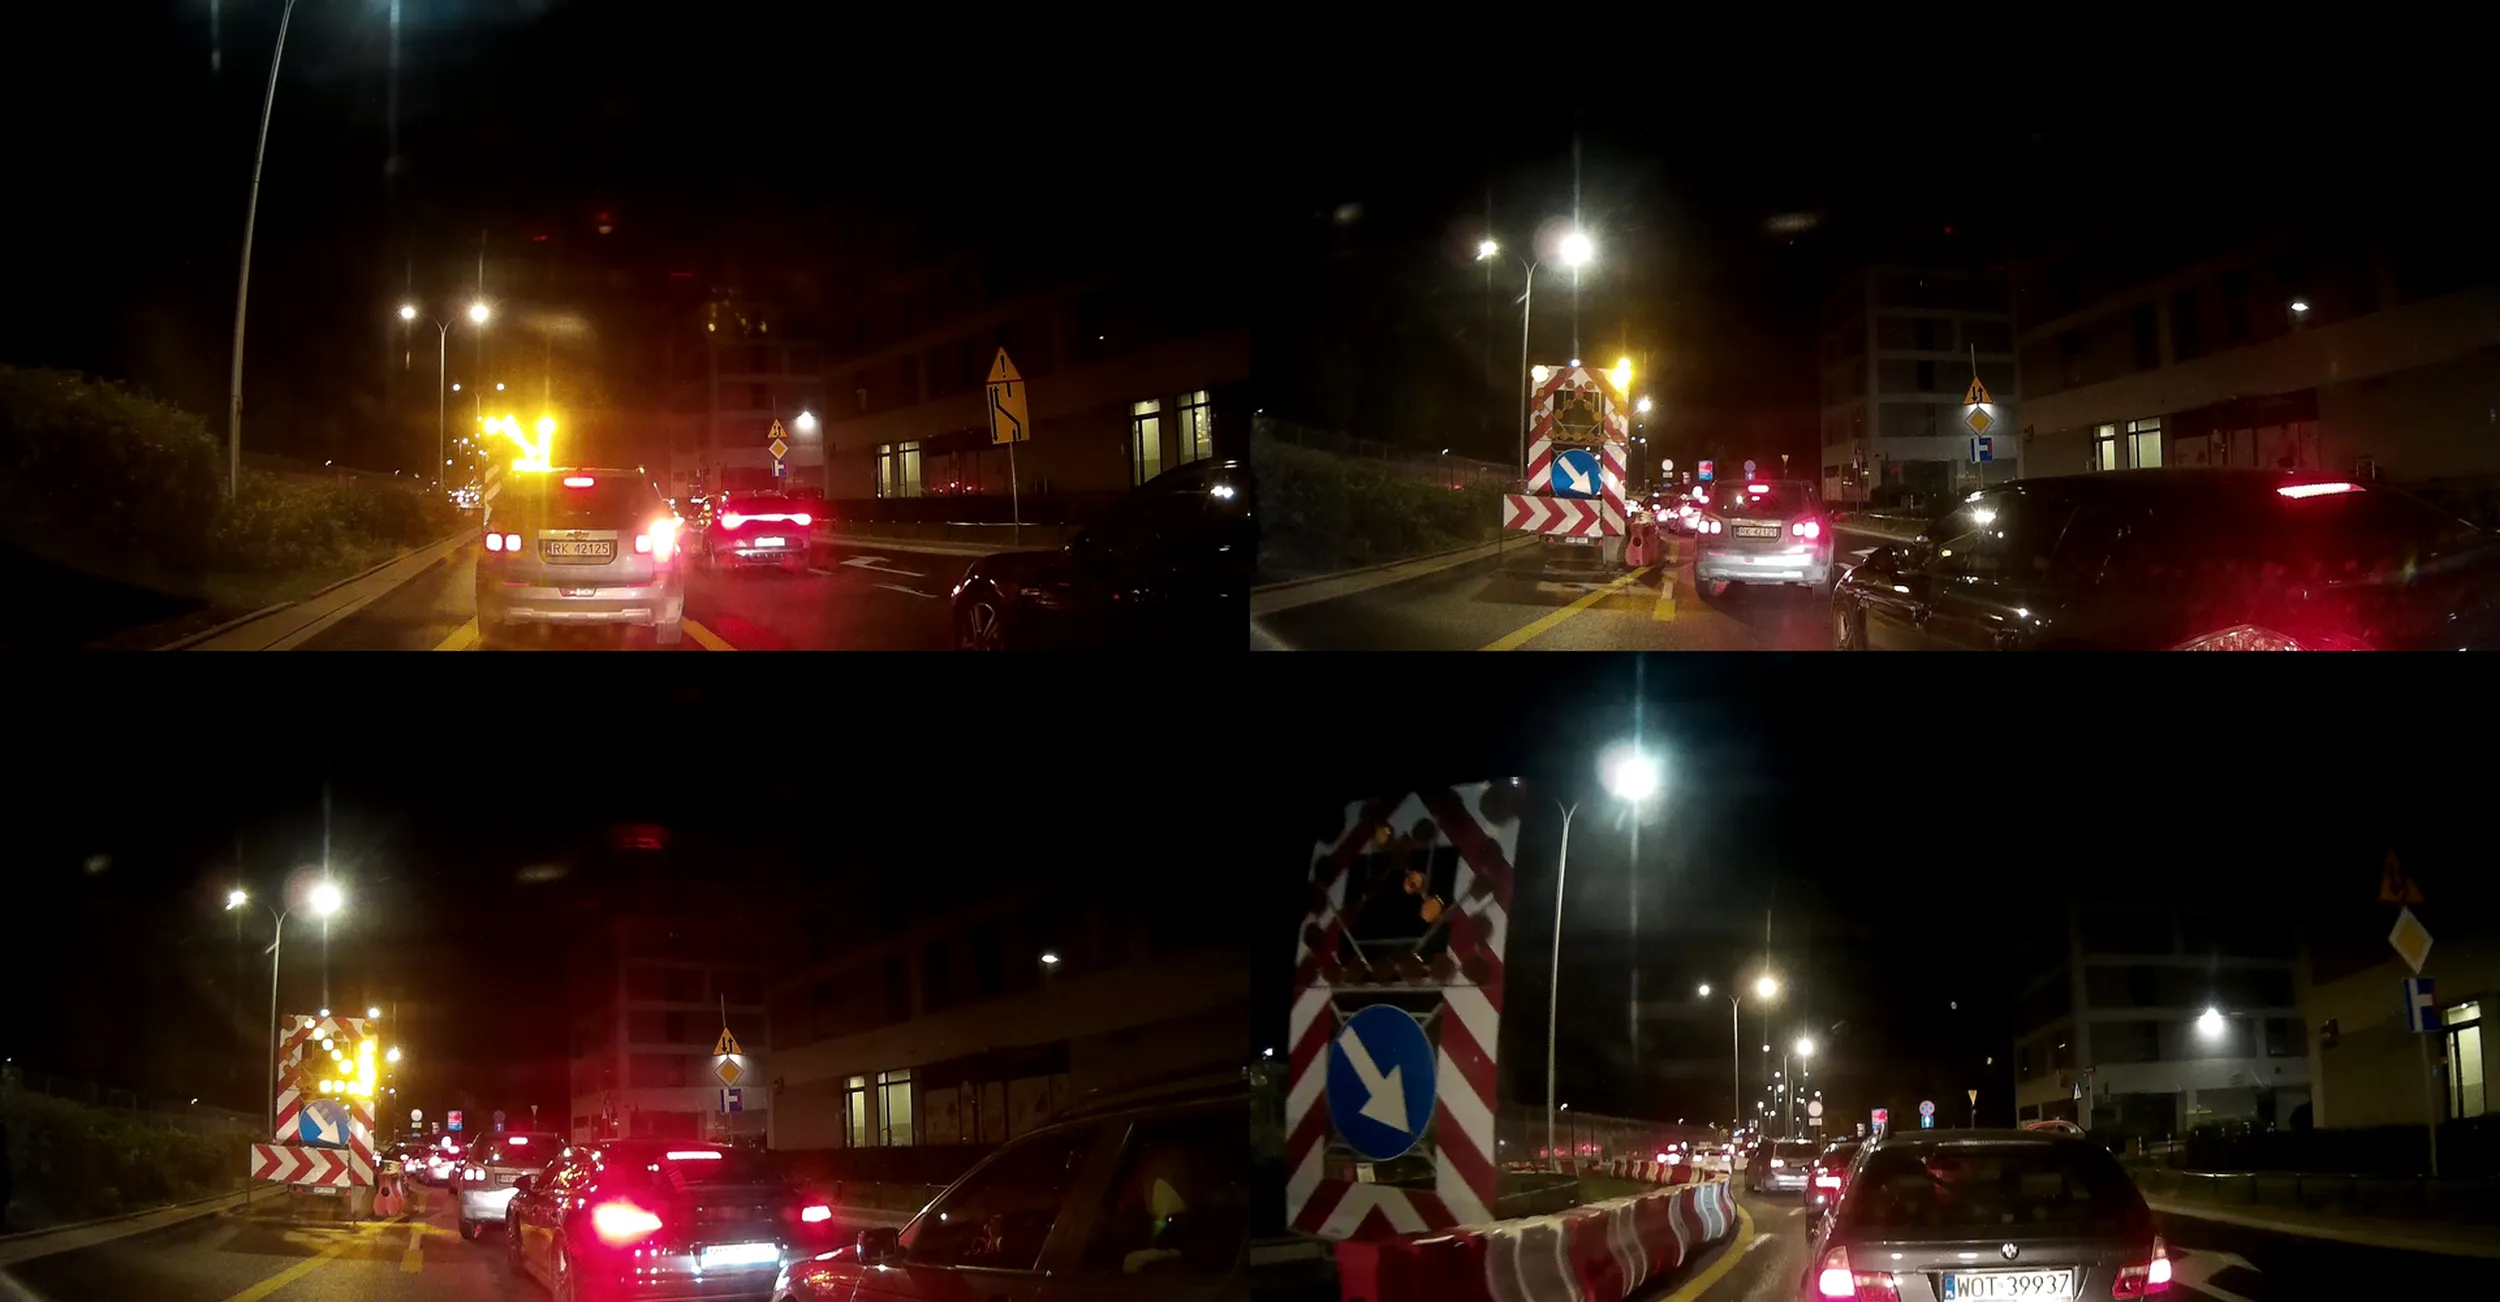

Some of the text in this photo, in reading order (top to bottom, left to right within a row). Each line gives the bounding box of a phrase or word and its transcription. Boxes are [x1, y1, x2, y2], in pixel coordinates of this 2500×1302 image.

[553, 543, 609, 554] RK 42125
[1957, 1273, 2069, 1297] WOT 39937
